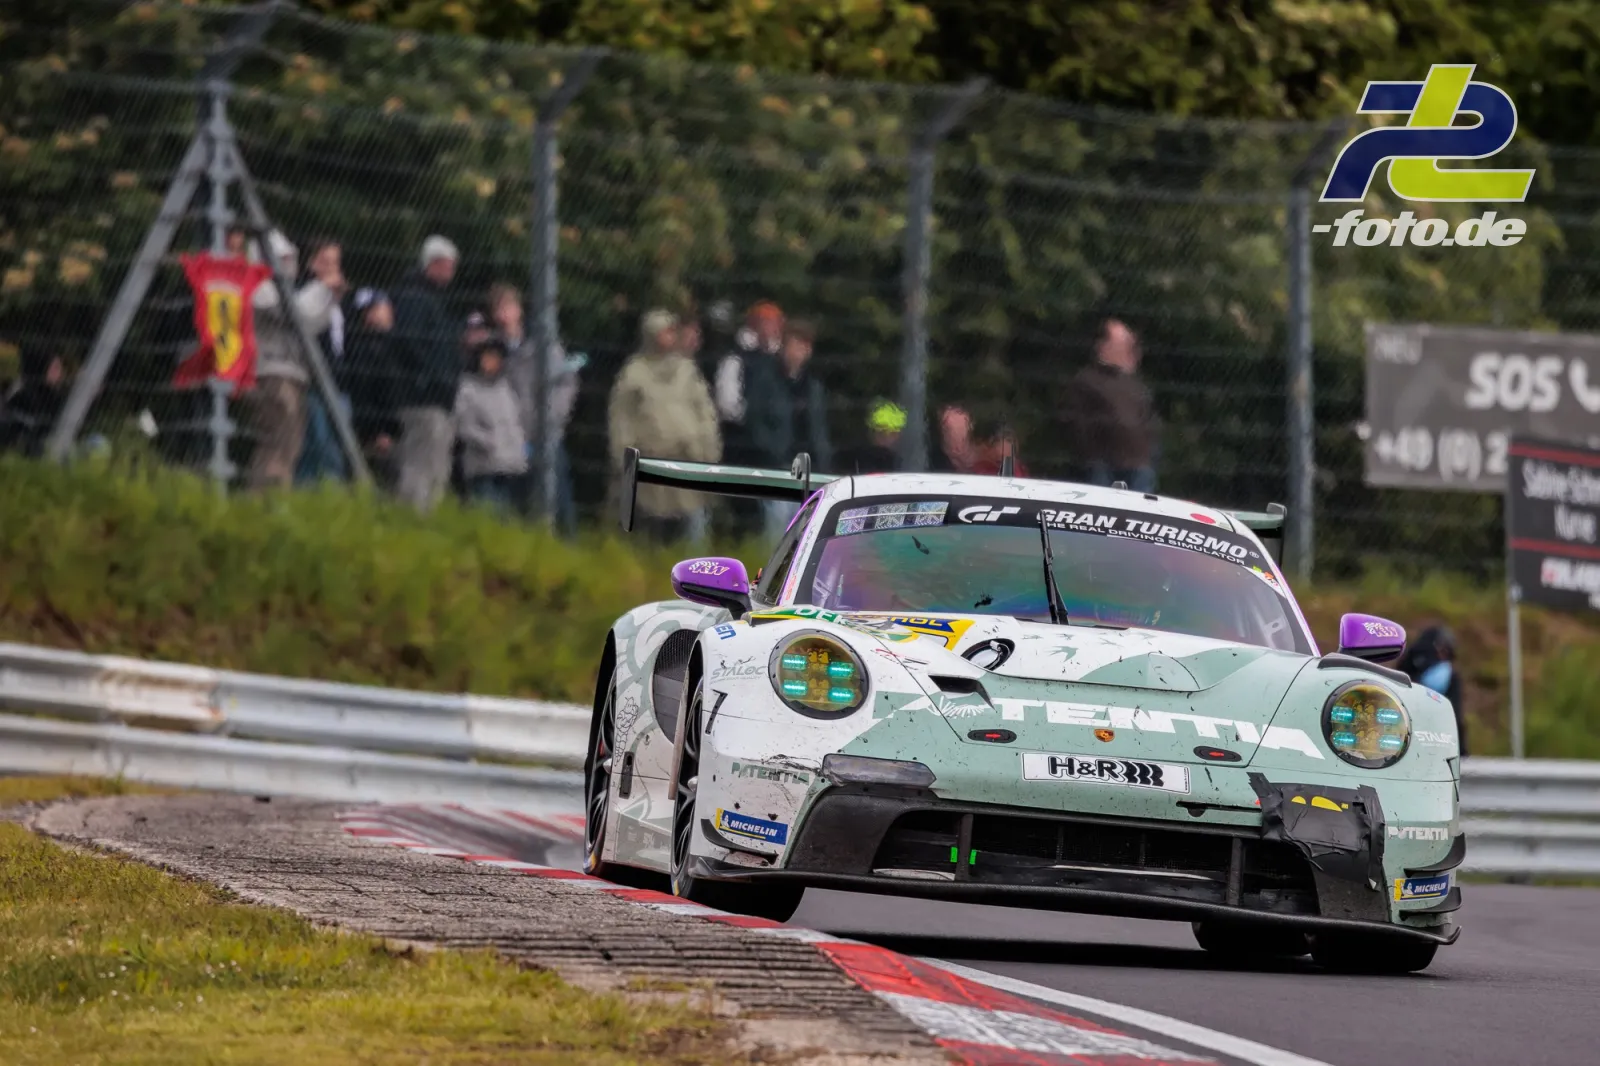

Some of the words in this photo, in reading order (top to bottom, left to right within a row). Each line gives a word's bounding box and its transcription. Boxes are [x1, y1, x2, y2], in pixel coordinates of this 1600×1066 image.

[1465, 352, 1564, 411] SOS
[1036, 508, 1118, 529] GRAN
[1069, 524, 1106, 534] REAL
[1108, 529, 1165, 543] DRIVING
[1168, 539, 1246, 566] SIMULATOR
[710, 666, 768, 680] STALOC
[1049, 756, 1122, 781] H&R
[730, 819, 778, 837] MICHELIN
[1414, 882, 1447, 894] MICHELIN
